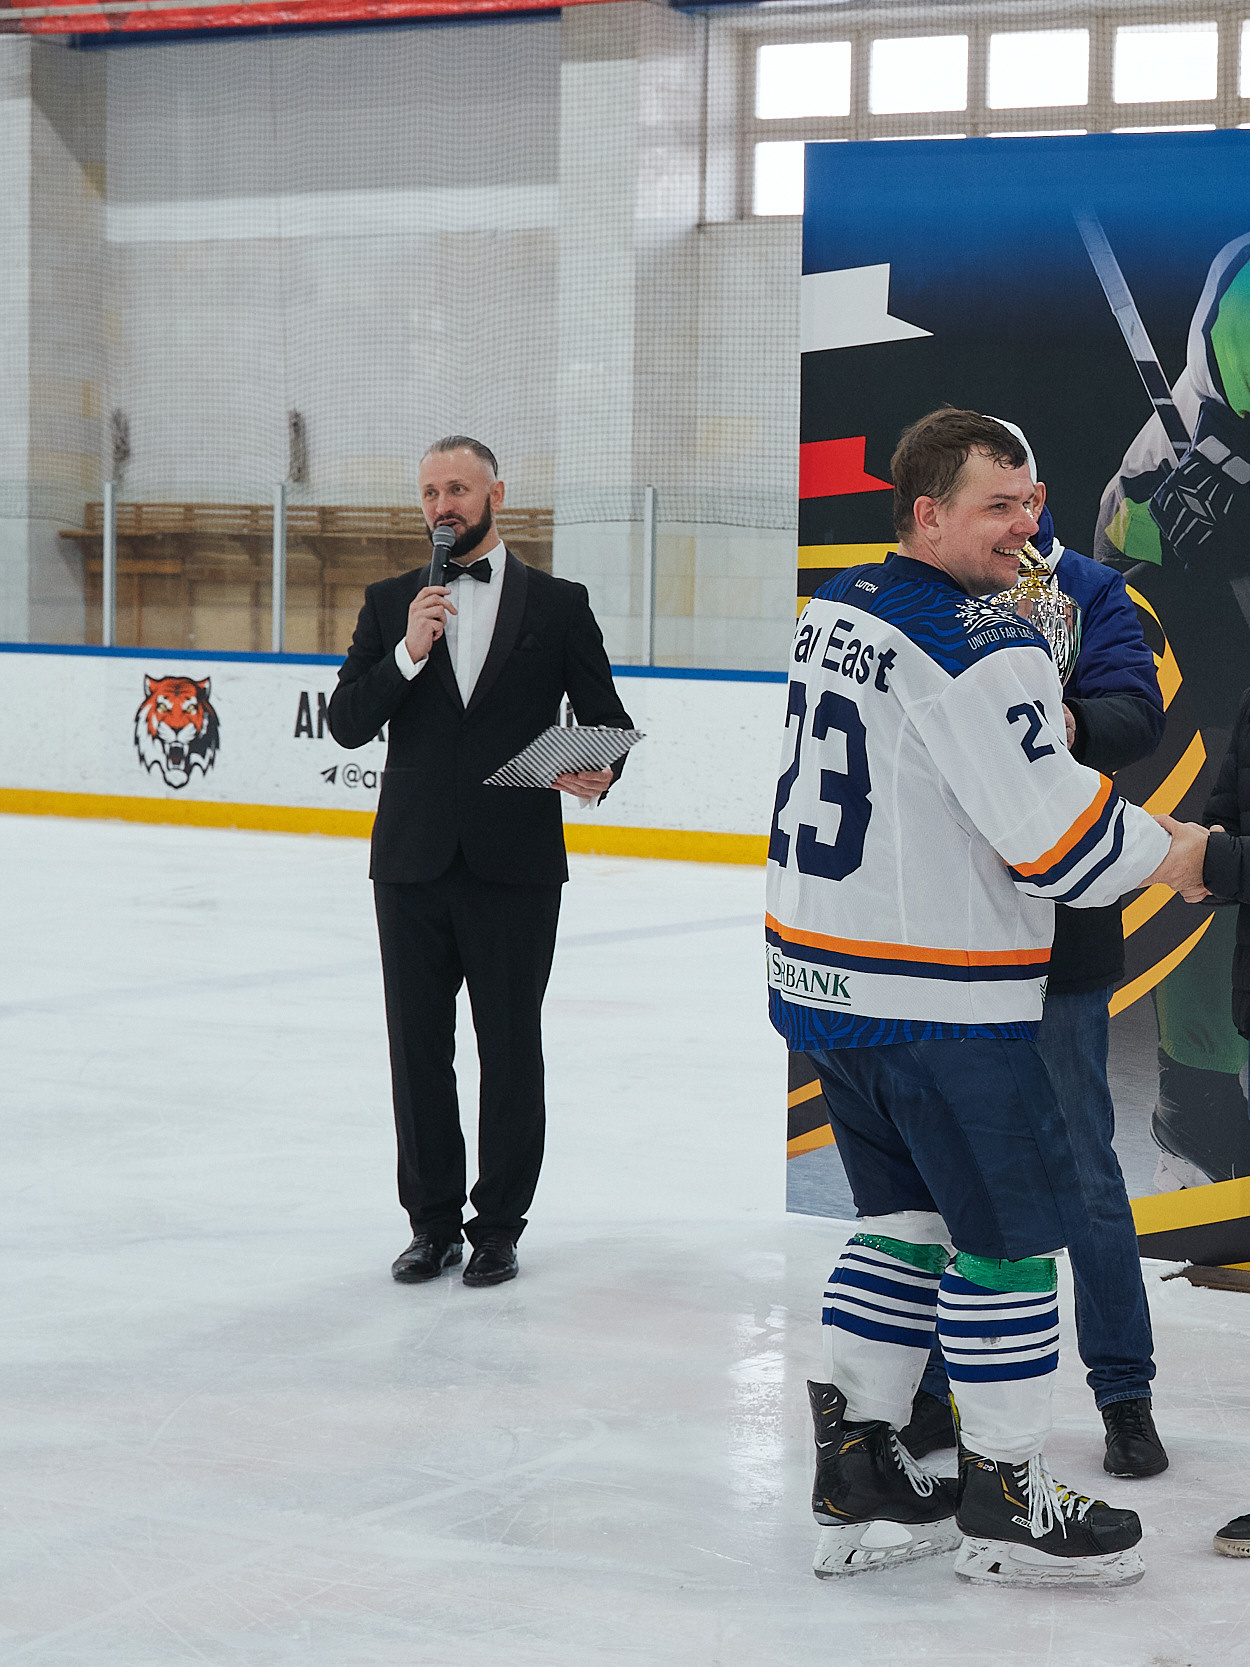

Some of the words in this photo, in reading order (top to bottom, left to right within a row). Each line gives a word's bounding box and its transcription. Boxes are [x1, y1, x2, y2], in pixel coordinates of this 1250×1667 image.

[854, 579, 879, 594] LUTCH
[967, 628, 1000, 651] UNITED
[999, 626, 1018, 640] FAR
[1017, 627, 1036, 641] EAS
[821, 618, 898, 694] East
